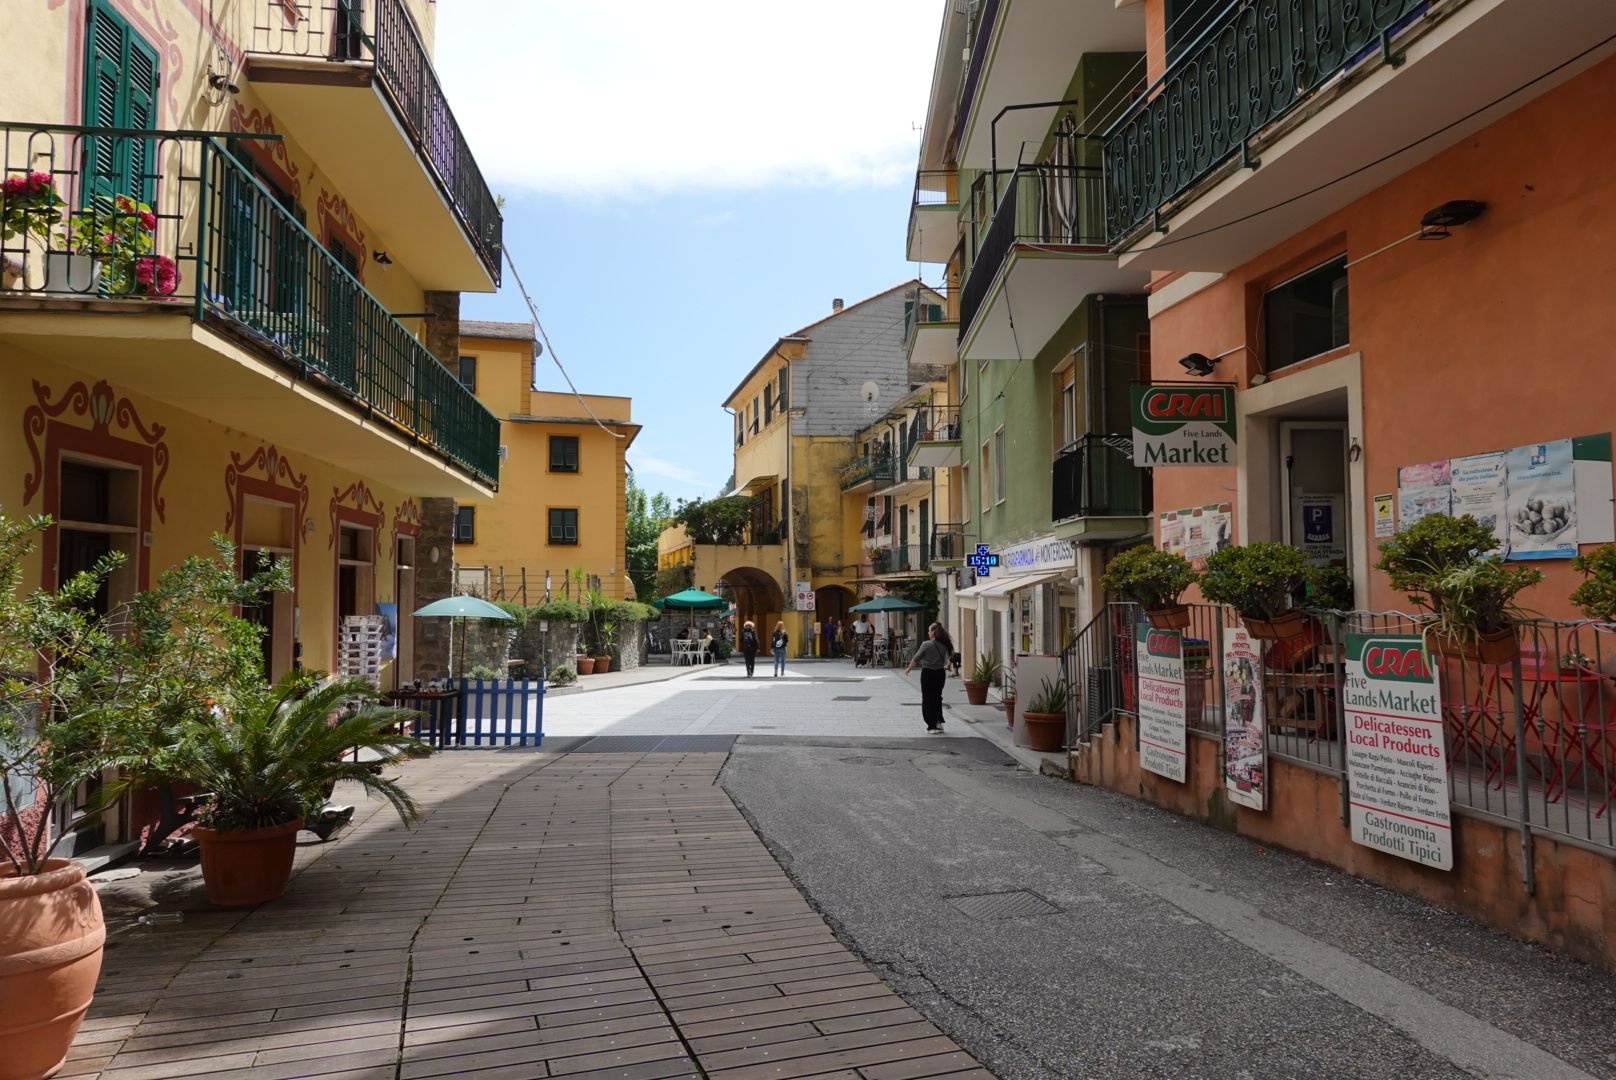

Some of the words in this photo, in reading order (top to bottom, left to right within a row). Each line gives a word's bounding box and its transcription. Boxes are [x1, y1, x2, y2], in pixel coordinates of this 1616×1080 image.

[1148, 393, 1222, 417] CRAI
[1183, 429, 1199, 438] Five
[1201, 430, 1223, 438] Lands
[1144, 440, 1228, 464] Market
[1312, 508, 1322, 522] P
[970, 556, 996, 565] 15:10
[1040, 540, 1073, 563] MONTEROSSO
[1138, 651, 1149, 662] Five
[1154, 662, 1183, 680] Market
[1142, 680, 1180, 697] Delicatessen
[1345, 672, 1367, 689] Five
[1140, 690, 1153, 702] Local
[1155, 693, 1183, 709] Products
[1346, 689, 1377, 708] Lands
[1379, 689, 1437, 715] Market
[1354, 715, 1432, 739] Delicatessen
[1349, 730, 1378, 747] Local
[1383, 735, 1440, 758] Products
[1146, 746, 1179, 765] Gastronomia
[1144, 756, 1165, 770] Prodotti
[1165, 764, 1181, 777] Tipici
[1396, 758, 1416, 768] Muscoli
[1416, 761, 1435, 772] Ripieni
[1400, 769, 1422, 781] Acciughe
[1423, 773, 1442, 784] Ripiene
[1397, 780, 1417, 790] Arancini
[1424, 785, 1435, 794] Riso
[1399, 791, 1412, 800] Pollo
[1417, 805, 1435, 818] Verdure
[1365, 812, 1441, 843] Gastronomia
[1362, 826, 1405, 852] Prodotti
[1408, 840, 1441, 863] Tipici
